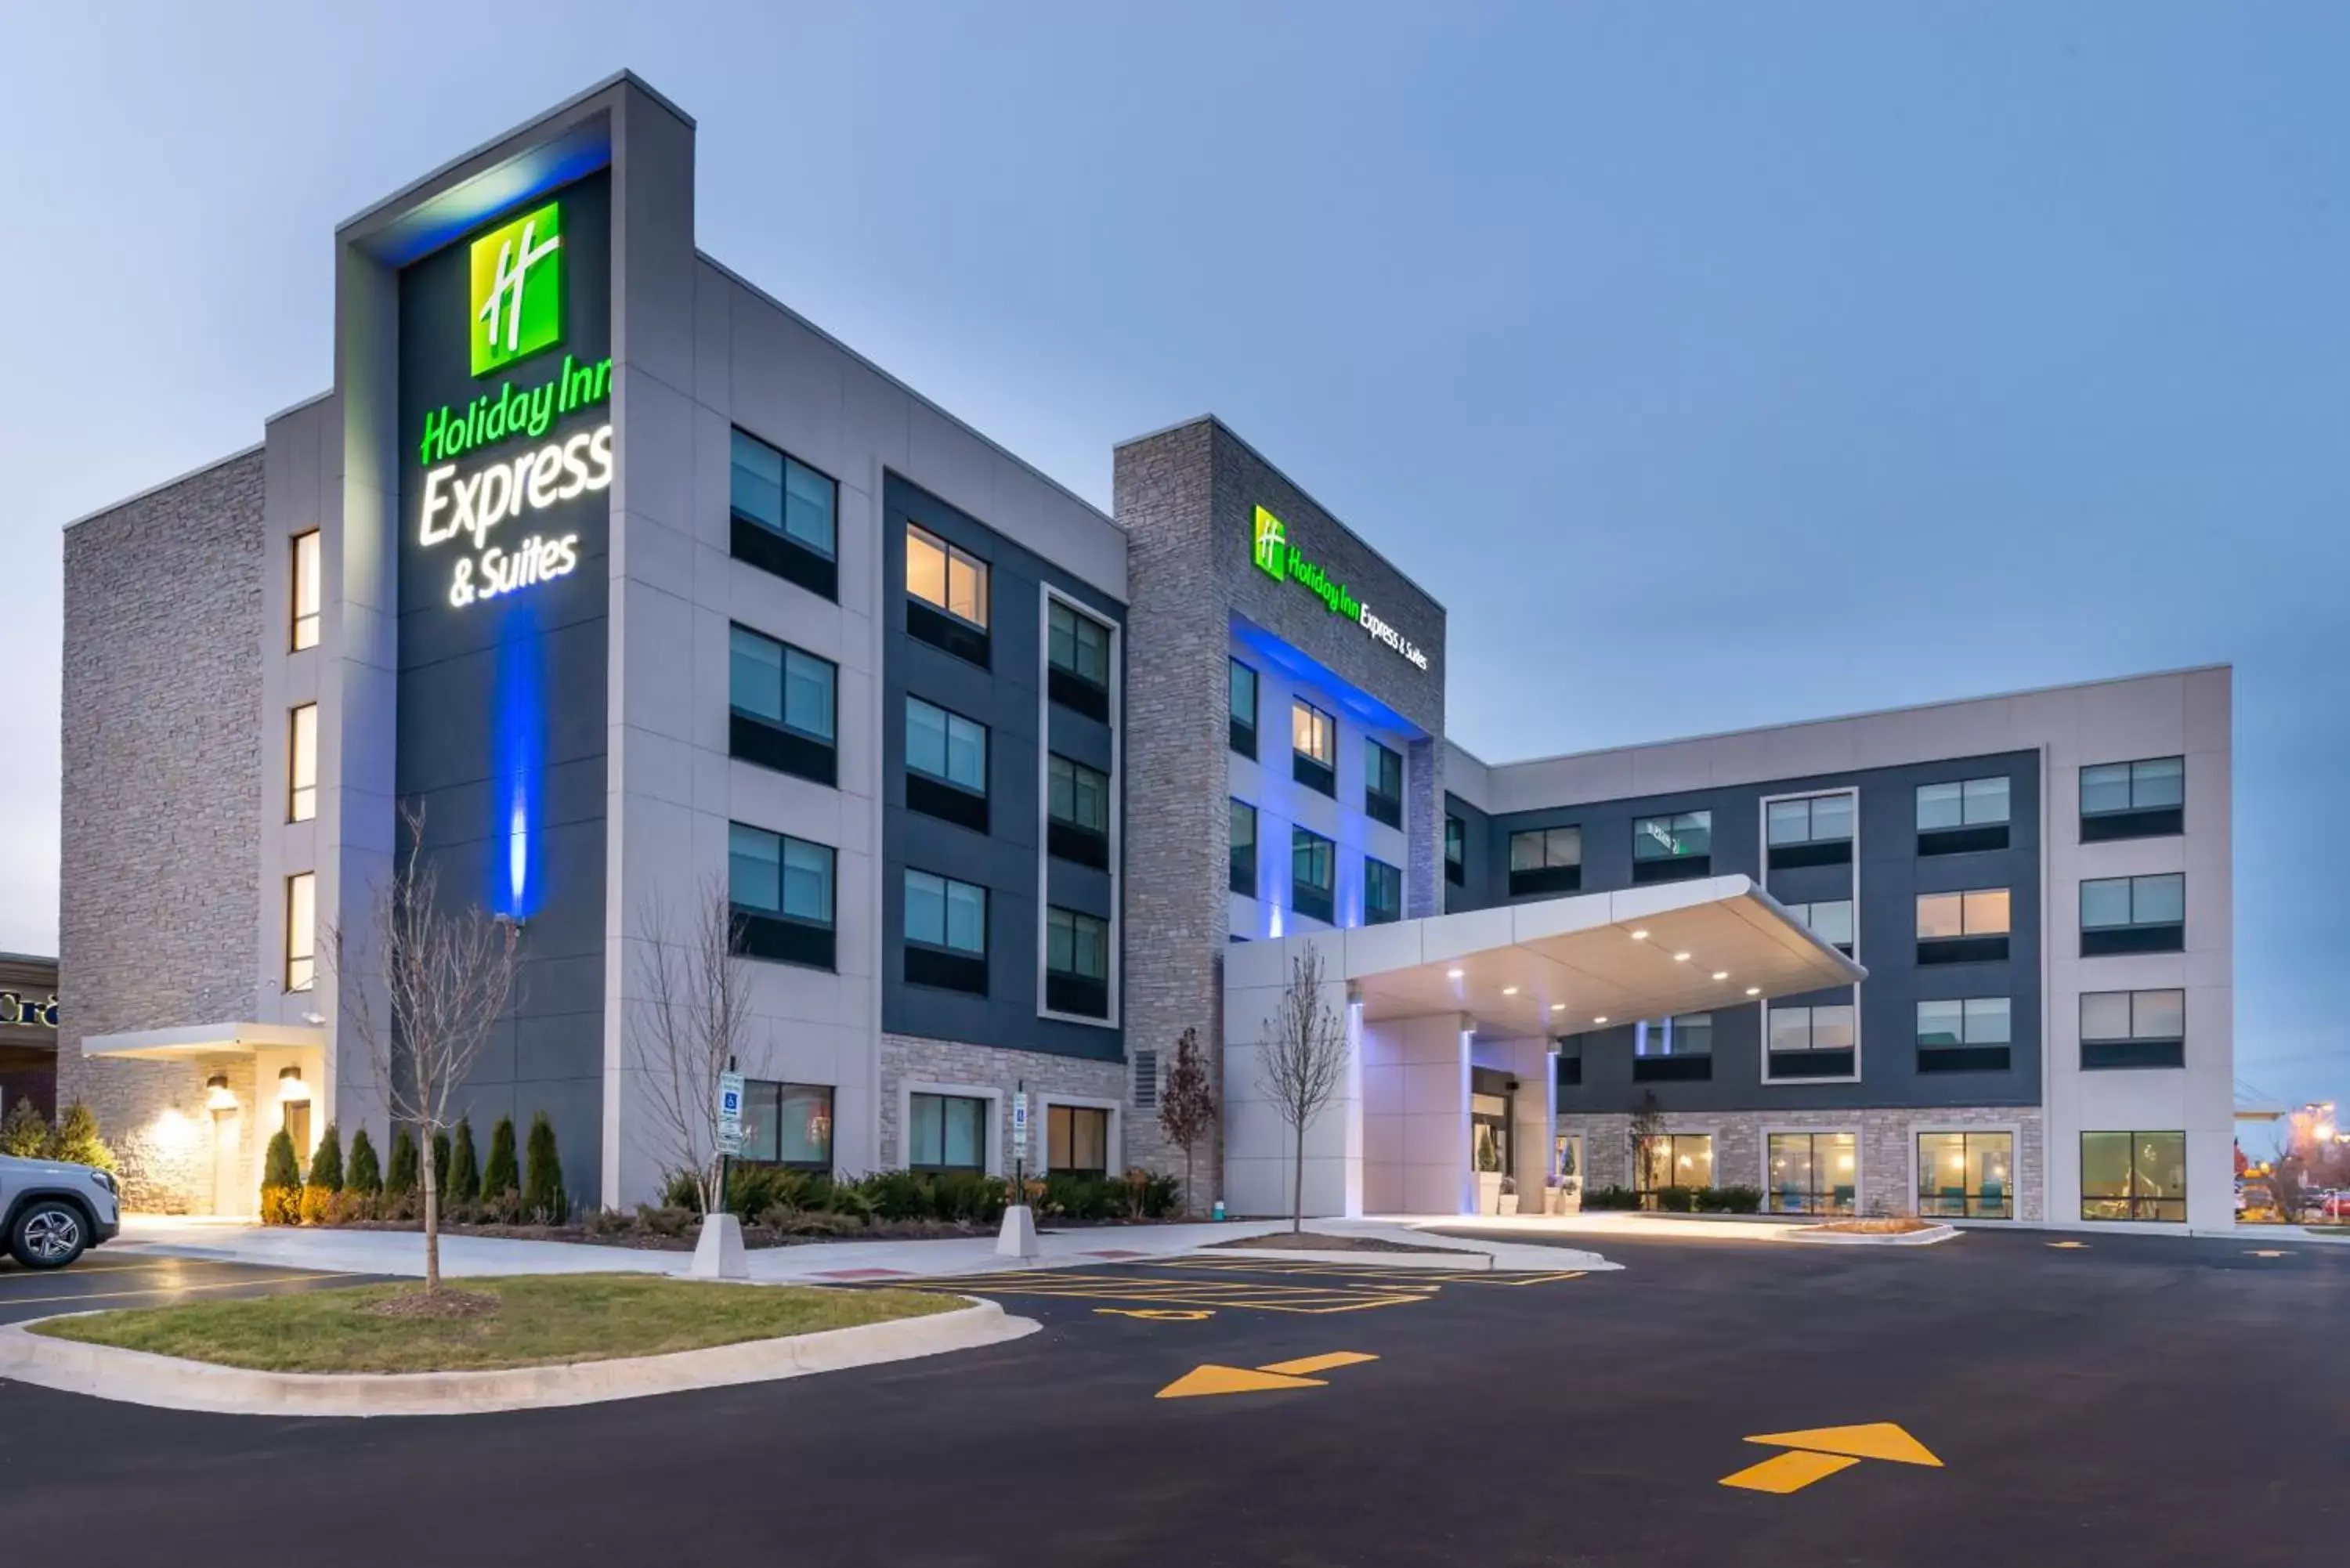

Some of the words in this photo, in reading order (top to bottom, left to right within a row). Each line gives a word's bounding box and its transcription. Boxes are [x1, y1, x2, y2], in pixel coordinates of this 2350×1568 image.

[479, 220, 560, 350] H
[420, 379, 555, 465] Holiday
[559, 355, 612, 412] Inn
[419, 425, 613, 548] Express
[450, 557, 475, 608] &
[478, 534, 578, 599] Suites
[1289, 545, 1339, 612] Holiday
[1340, 584, 1359, 621] Inn
[1360, 602, 1399, 649] Express
[1398, 637, 1405, 655] &
[1405, 641, 1428, 670] Suites
